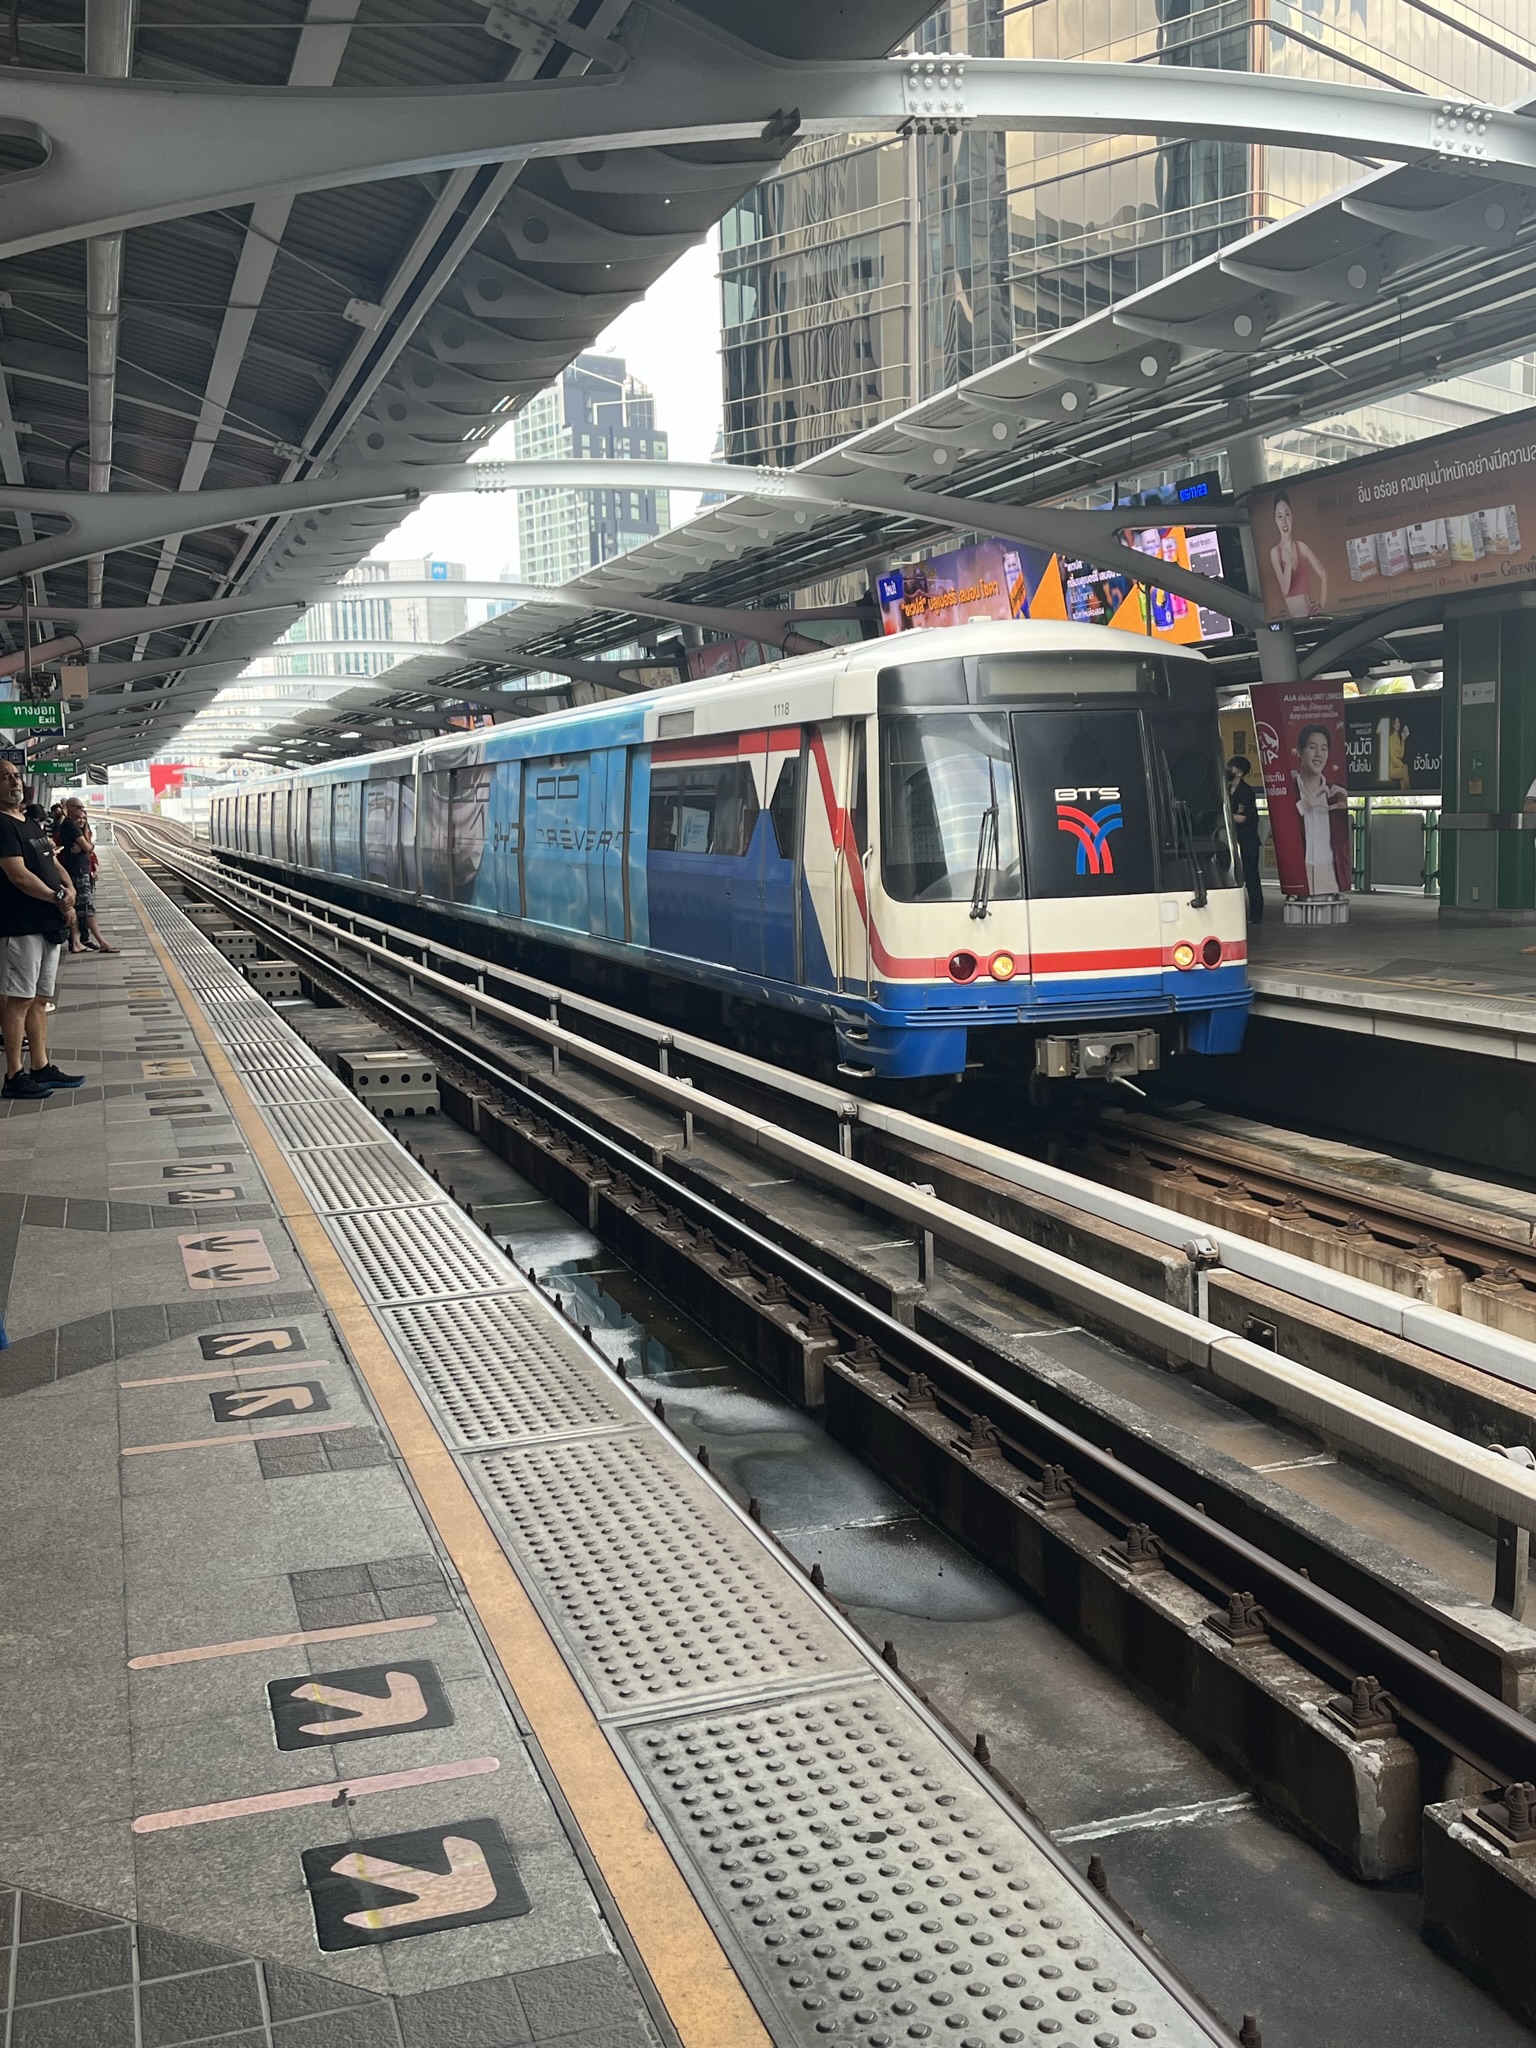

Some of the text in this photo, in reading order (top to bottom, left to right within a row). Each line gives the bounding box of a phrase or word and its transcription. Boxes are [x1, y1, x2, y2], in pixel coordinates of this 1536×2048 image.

[1357, 481, 1371, 503] อิ่ม
[1374, 479, 1399, 499] อร่อย
[1201, 538, 1212, 547] train
[980, 578, 1000, 598] โซดา
[1283, 694, 1297, 702] AIA
[13, 705, 56, 716] ทางออก
[773, 702, 790, 717] 1118
[38, 716, 56, 724] Exit
[1376, 717, 1390, 781] 1
[1055, 787, 1121, 801] BTS
